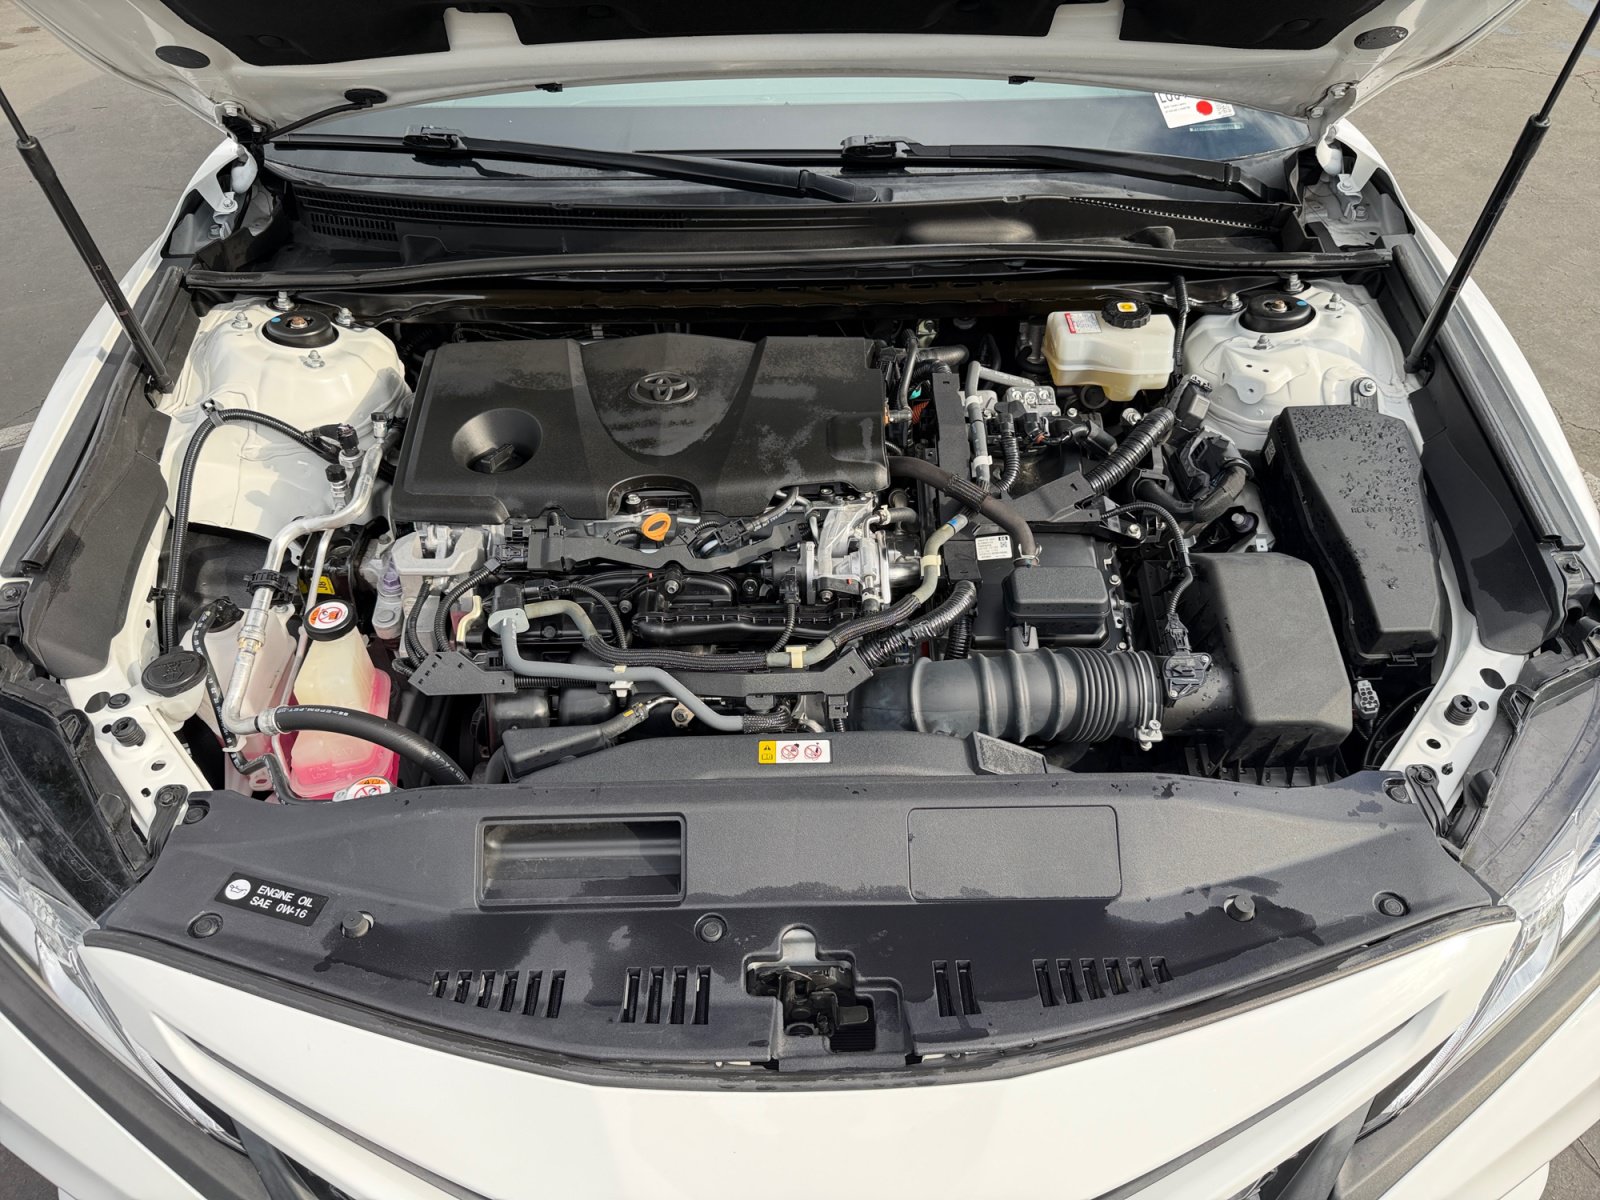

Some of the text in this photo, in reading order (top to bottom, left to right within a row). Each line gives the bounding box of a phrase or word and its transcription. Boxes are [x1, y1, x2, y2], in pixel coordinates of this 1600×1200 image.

[249, 896, 308, 919] SAE 0W-16
[257, 885, 313, 908] ENGINE OIL
